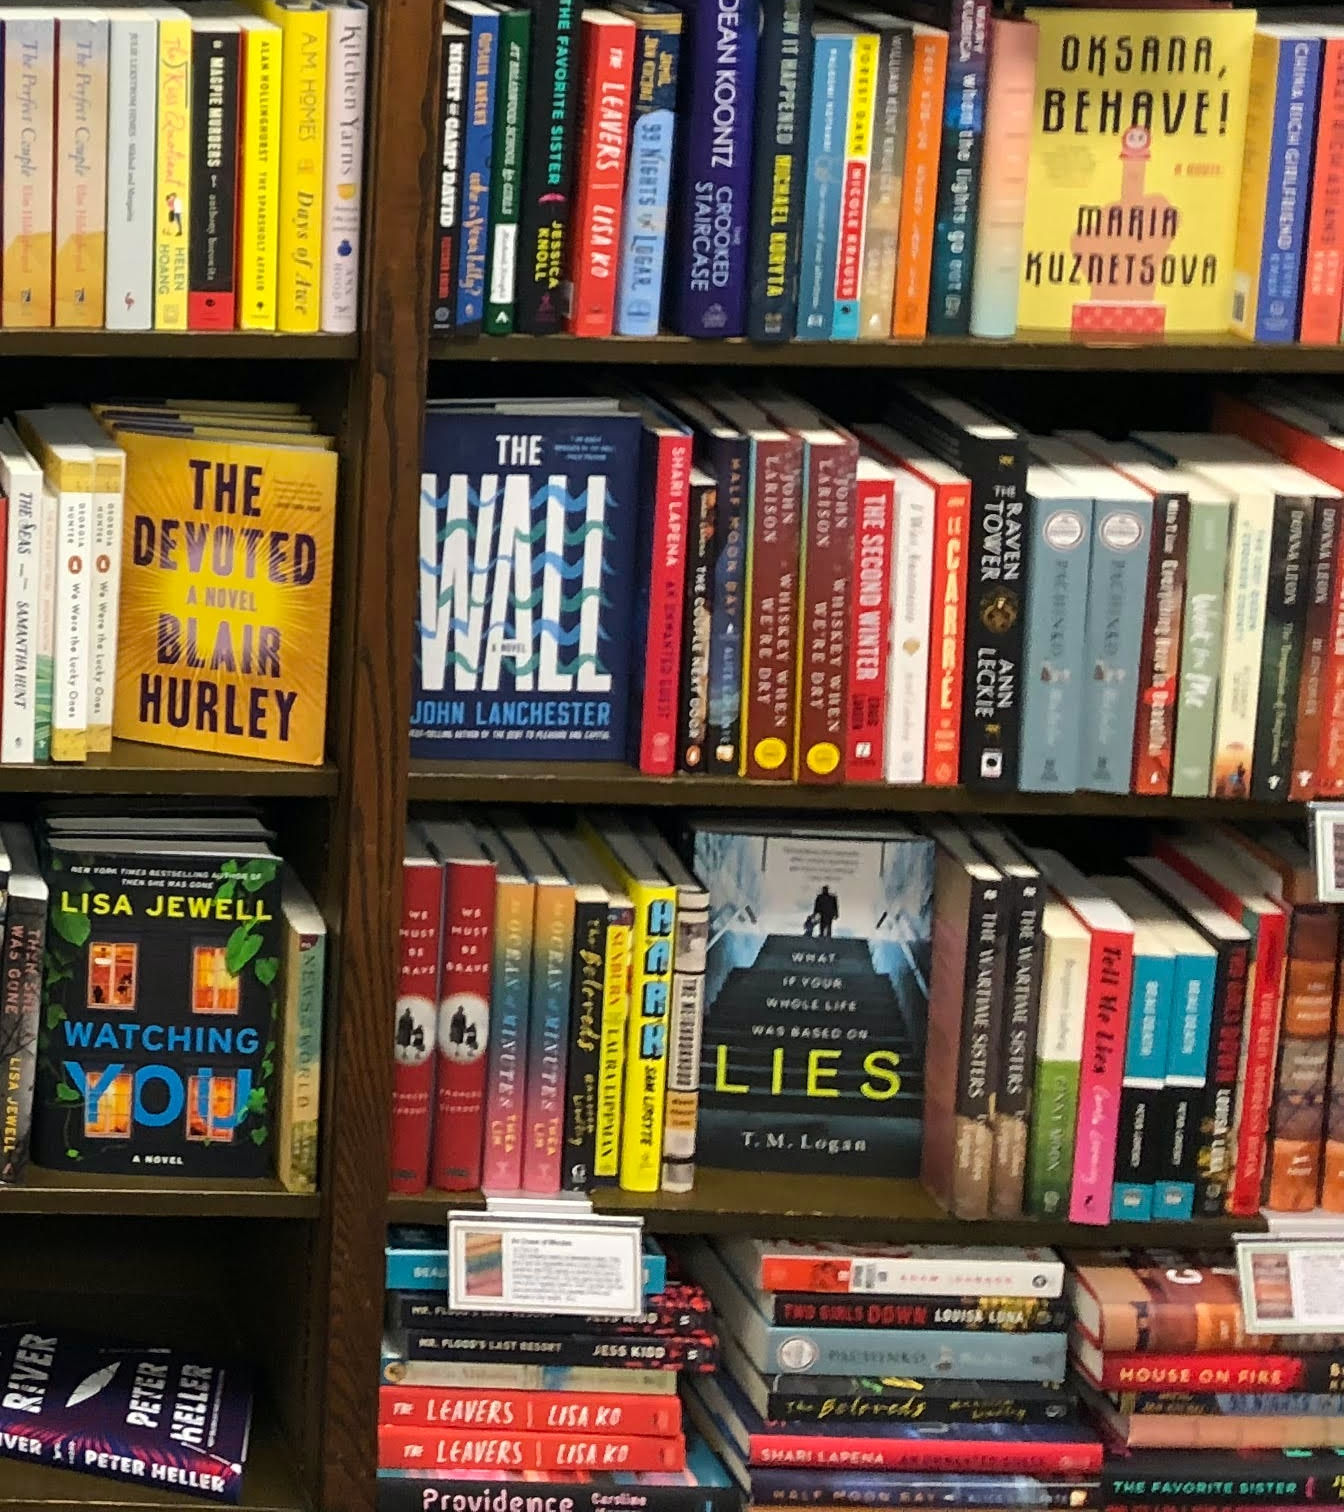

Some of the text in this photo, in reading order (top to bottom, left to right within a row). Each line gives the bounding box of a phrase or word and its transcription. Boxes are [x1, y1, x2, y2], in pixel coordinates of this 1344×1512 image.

[1061, 34, 1229, 79] OKSANA,
[711, 70, 737, 169] KOONTZ
[1042, 89, 1230, 136] BEHAVE!
[1077, 206, 1180, 241] MARIA
[1025, 251, 1218, 286] KUZNETSOVA
[496, 434, 543, 467] THE
[188, 459, 263, 517] THE
[132, 514, 318, 587] DEVOTED
[419, 474, 613, 692] WALL
[156, 612, 282, 679] BLAIR
[139, 673, 299, 743] HURLEY
[409, 701, 611, 726] JOHN LANCHESTER
[60, 891, 273, 923] LISA JEWELL
[64, 1020, 260, 1055] WATCHING
[63, 1061, 253, 1129] YOU
[715, 1044, 901, 1101] LIES
[426, 1399, 621, 1427] LEAVERS LISA KO
